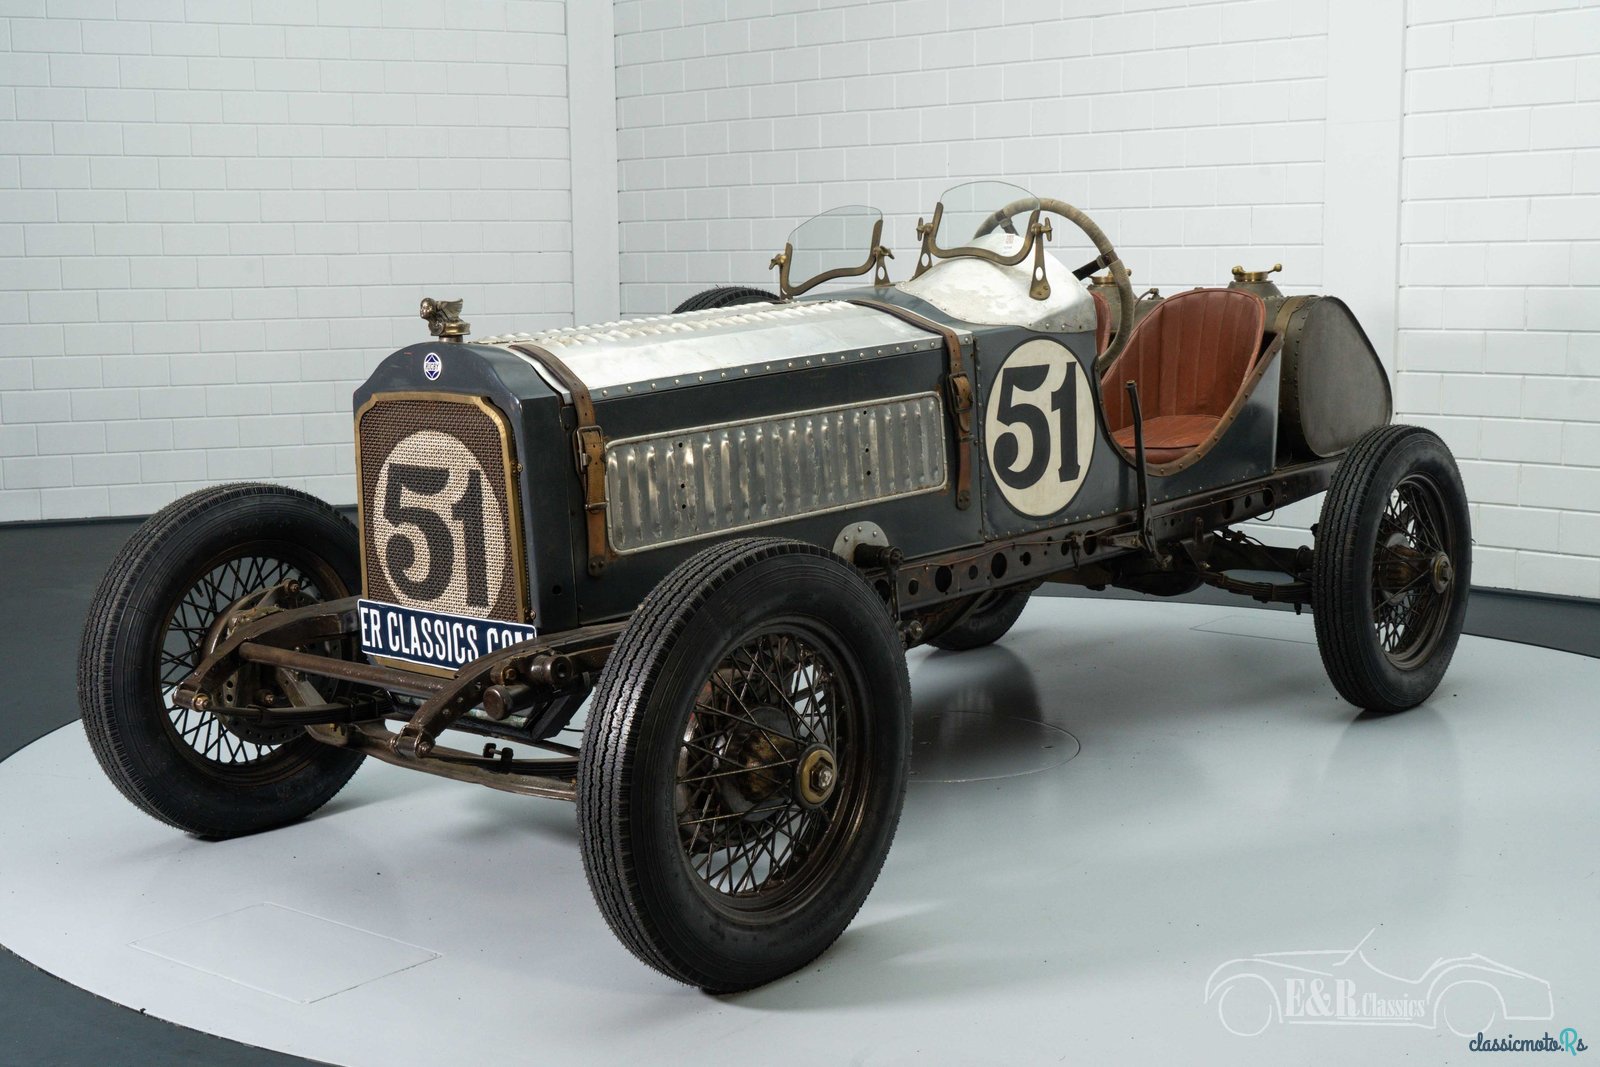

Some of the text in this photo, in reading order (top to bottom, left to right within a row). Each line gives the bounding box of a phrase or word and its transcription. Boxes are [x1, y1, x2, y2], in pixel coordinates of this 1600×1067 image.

[993, 361, 1081, 490] 51
[384, 463, 489, 608] 51
[360, 607, 534, 664] ER CLASSICS CO
